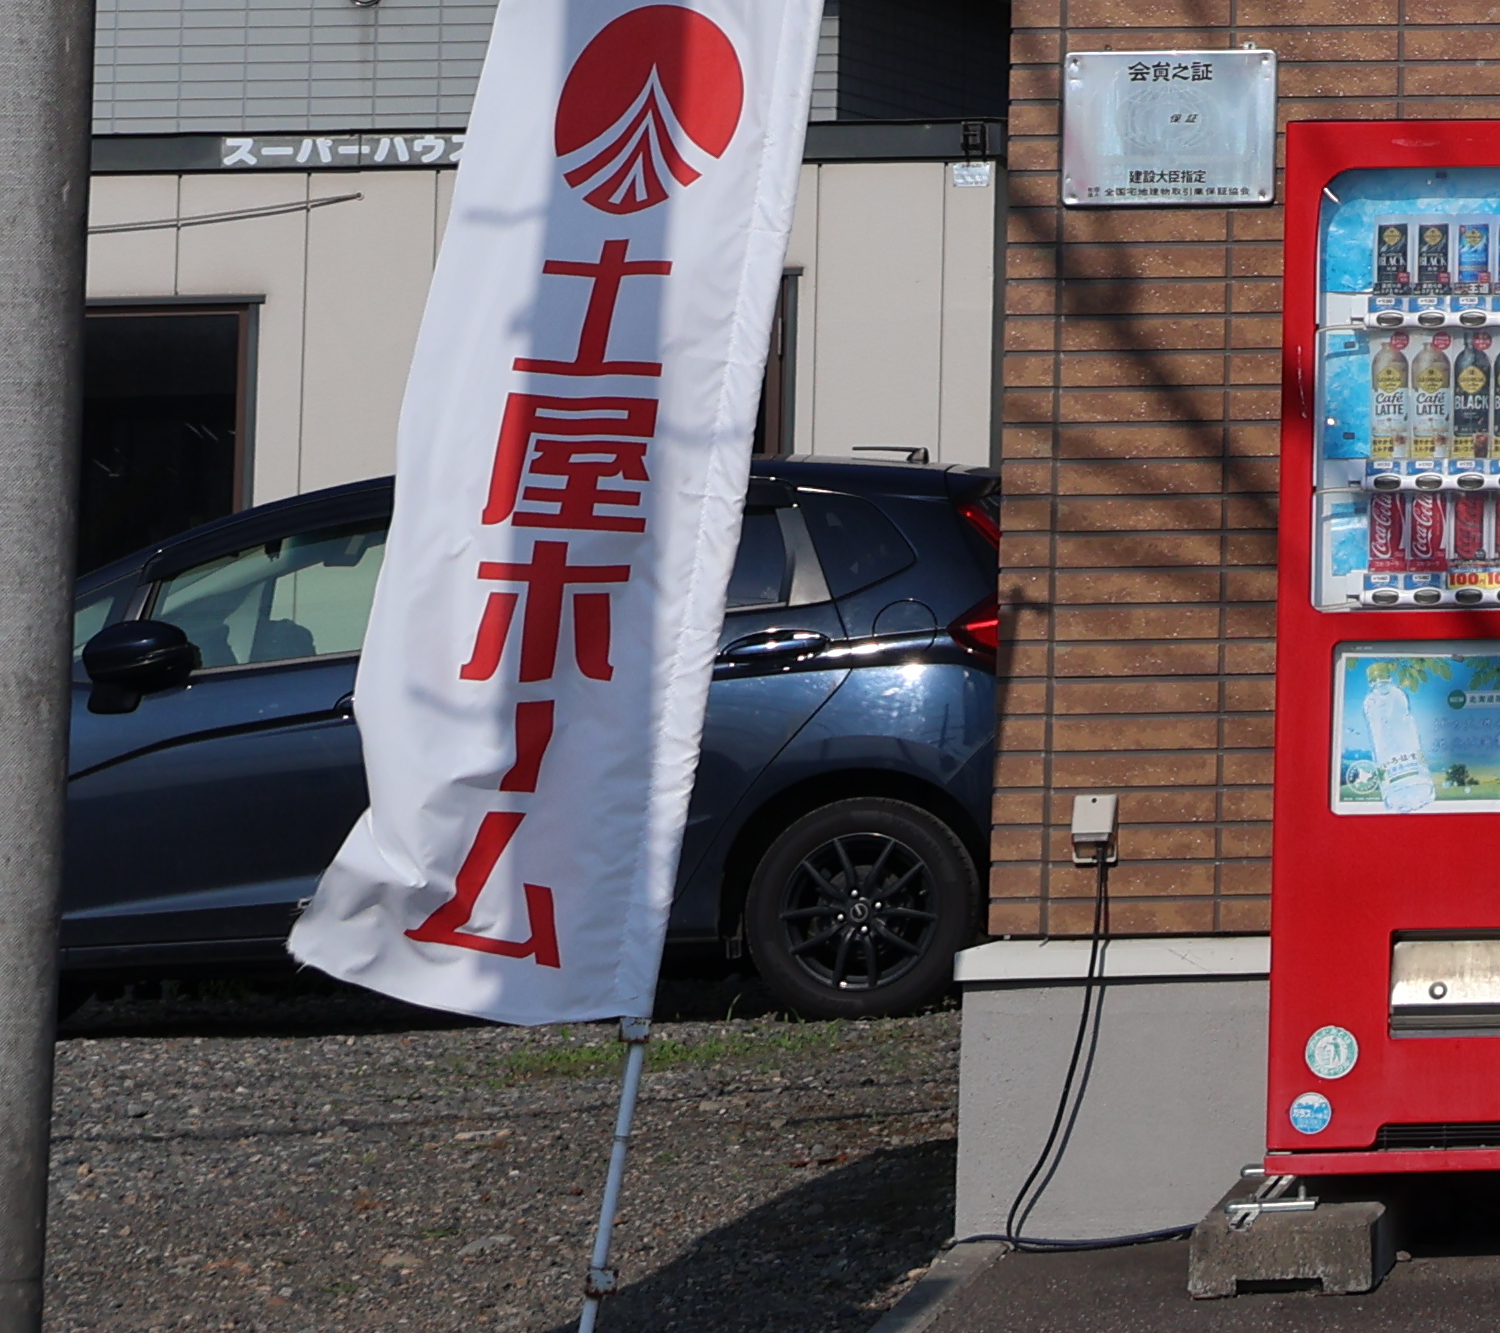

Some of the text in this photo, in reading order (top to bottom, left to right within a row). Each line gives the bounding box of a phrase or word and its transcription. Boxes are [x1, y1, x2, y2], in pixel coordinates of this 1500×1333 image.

[1128, 170, 1207, 184] 建設大臣指定
[1375, 392, 1404, 404] Café
[1416, 392, 1445, 404] Café
[1454, 395, 1489, 410] BLACK
[1375, 404, 1404, 415] LATTE
[1416, 404, 1445, 415] LATTE
[405, 239, 673, 968] 土屋ホーム
